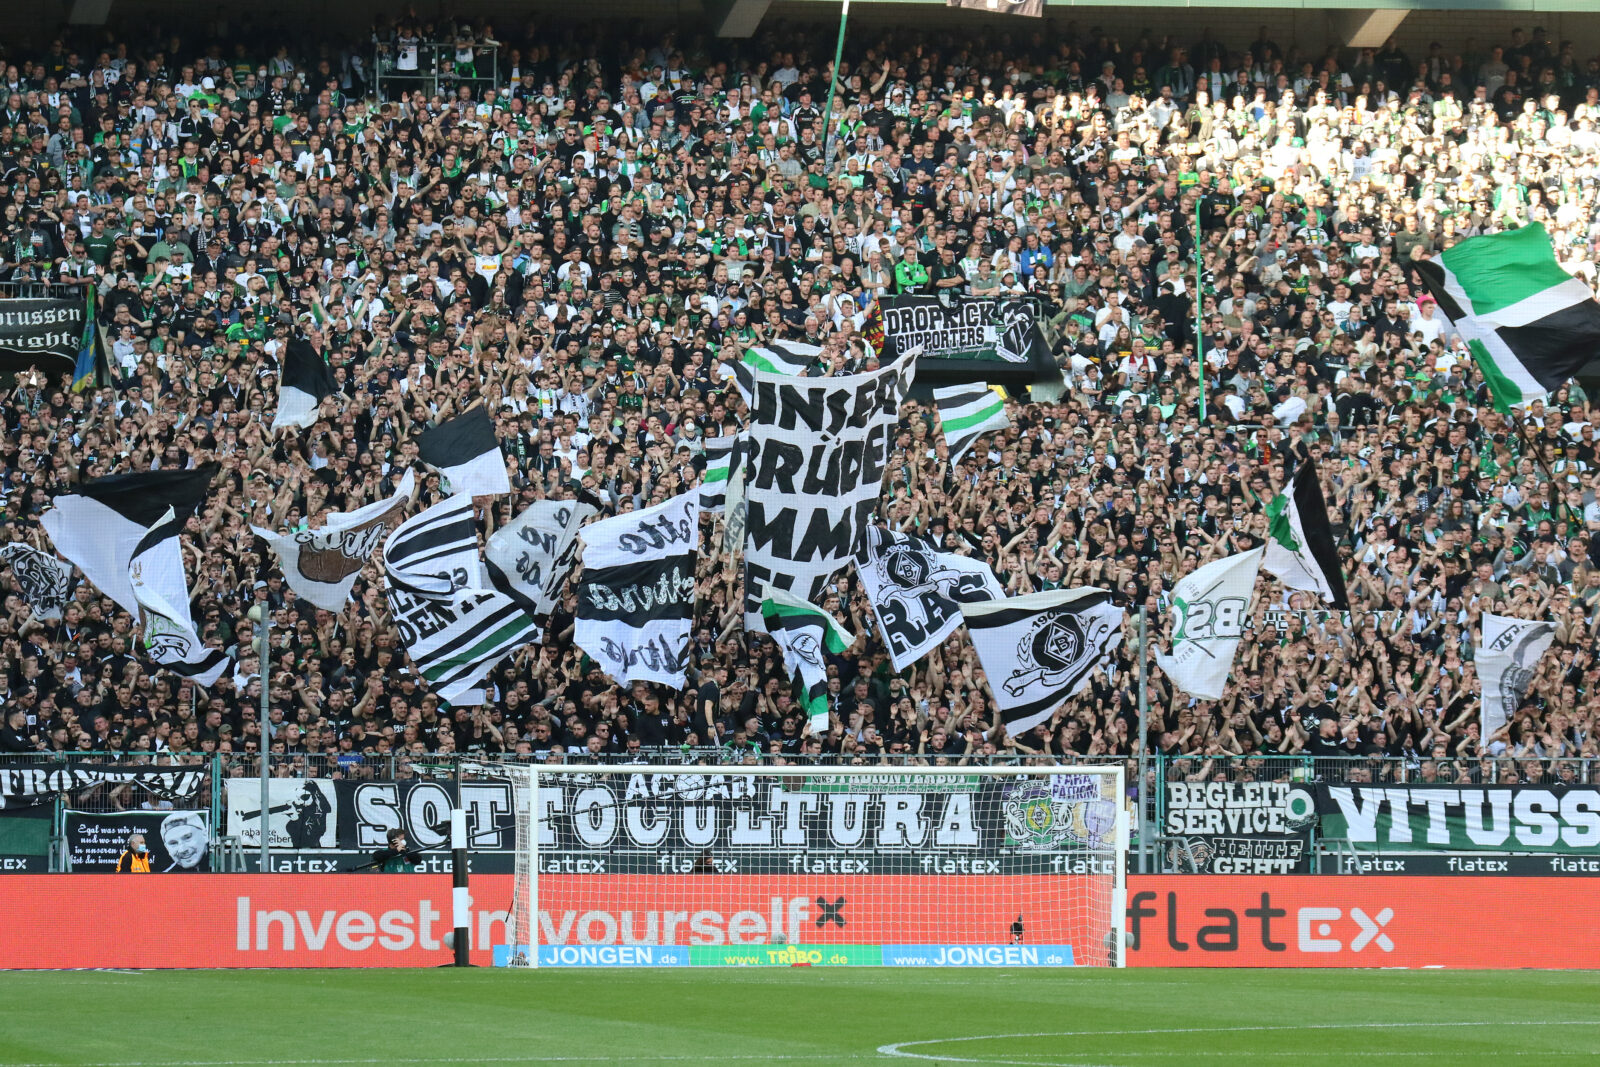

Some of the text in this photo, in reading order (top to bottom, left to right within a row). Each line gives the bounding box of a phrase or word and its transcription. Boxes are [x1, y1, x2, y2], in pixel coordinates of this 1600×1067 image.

[896, 326, 985, 354] SUPPORTERS
[1168, 782, 1290, 809] BEGLEIT
[1167, 808, 1285, 835] SERVICE
[1213, 837, 1304, 862] HEUTE
[1213, 856, 1295, 874] GEHT
[236, 896, 440, 950] Invest
[546, 946, 653, 964] JONGEN
[894, 955, 930, 965] www.
[934, 946, 1039, 965] JONGEN
